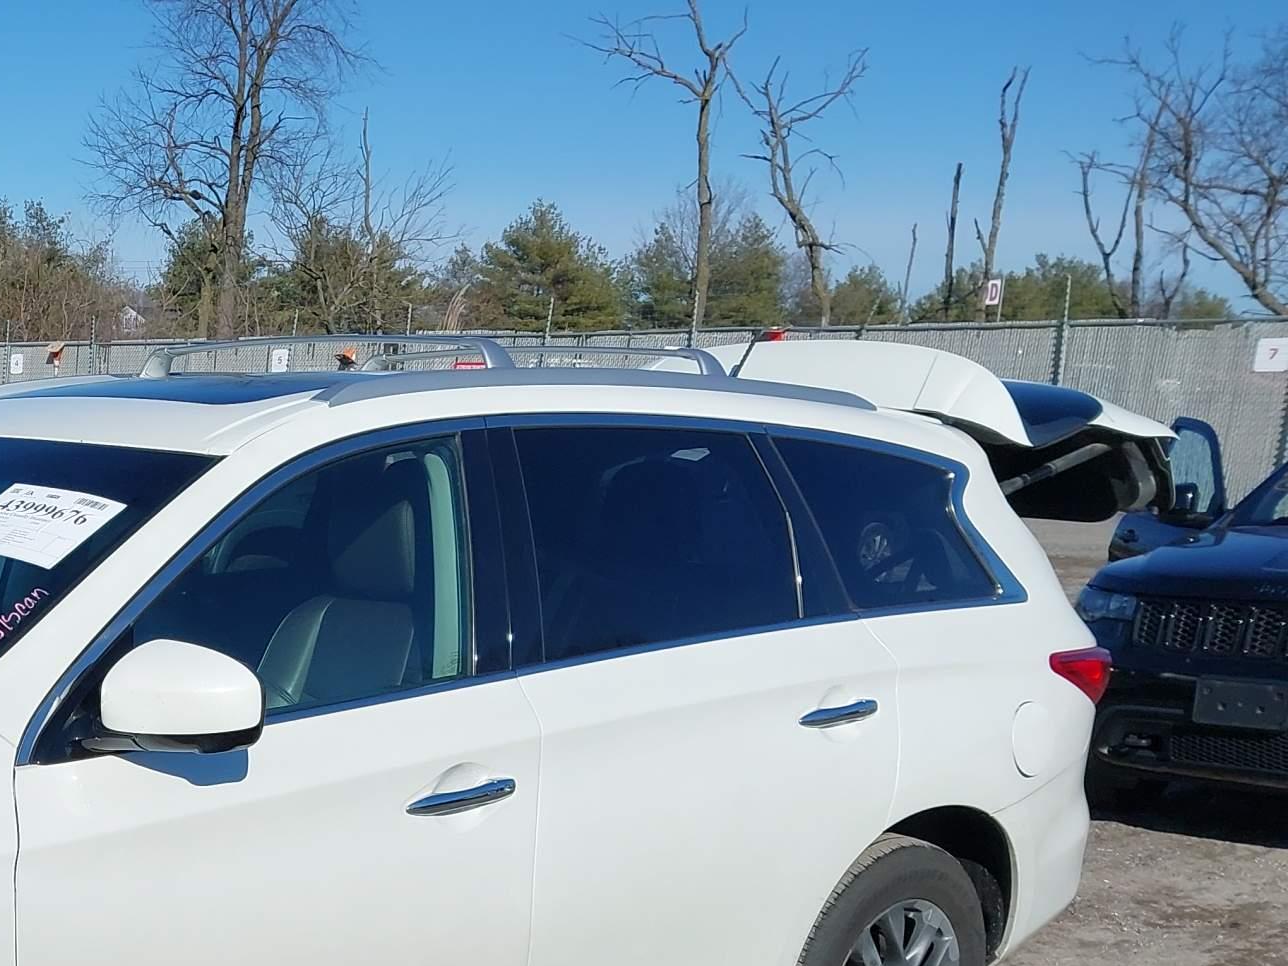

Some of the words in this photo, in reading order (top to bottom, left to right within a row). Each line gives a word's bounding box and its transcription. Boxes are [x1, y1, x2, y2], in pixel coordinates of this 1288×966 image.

[989, 283, 999, 301] D
[1269, 347, 1279, 360] 7
[0, 498, 93, 525] 43999676
